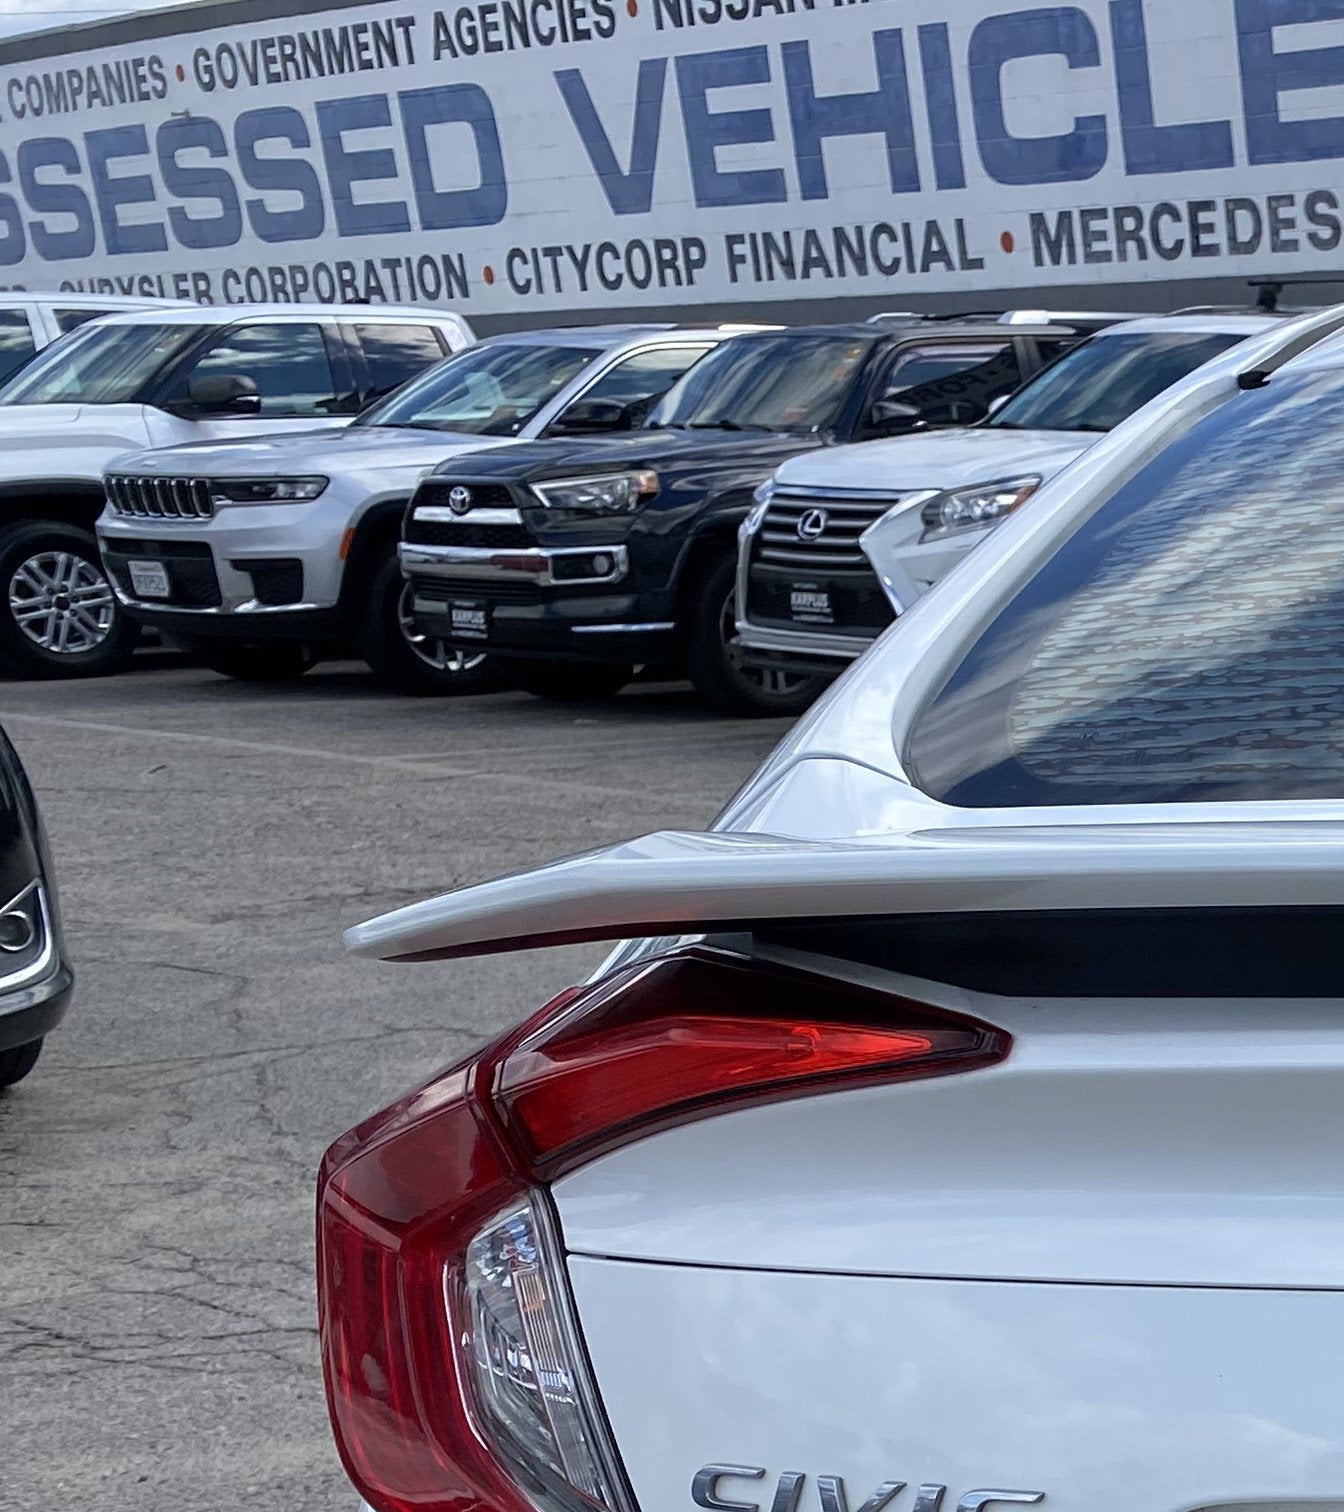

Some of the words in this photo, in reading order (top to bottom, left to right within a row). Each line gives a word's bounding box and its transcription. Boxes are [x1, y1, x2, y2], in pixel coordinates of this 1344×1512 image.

[7, 54, 167, 118] COMPANIES
[193, 16, 415, 92] GOVERNMENT
[433, 0, 616, 60] AGENCIES
[222, 253, 470, 304] CORPORATION
[505, 236, 707, 295] CITYCORP
[724, 217, 985, 284] FINANCIAL
[1030, 190, 1343, 268] MERCEDES
